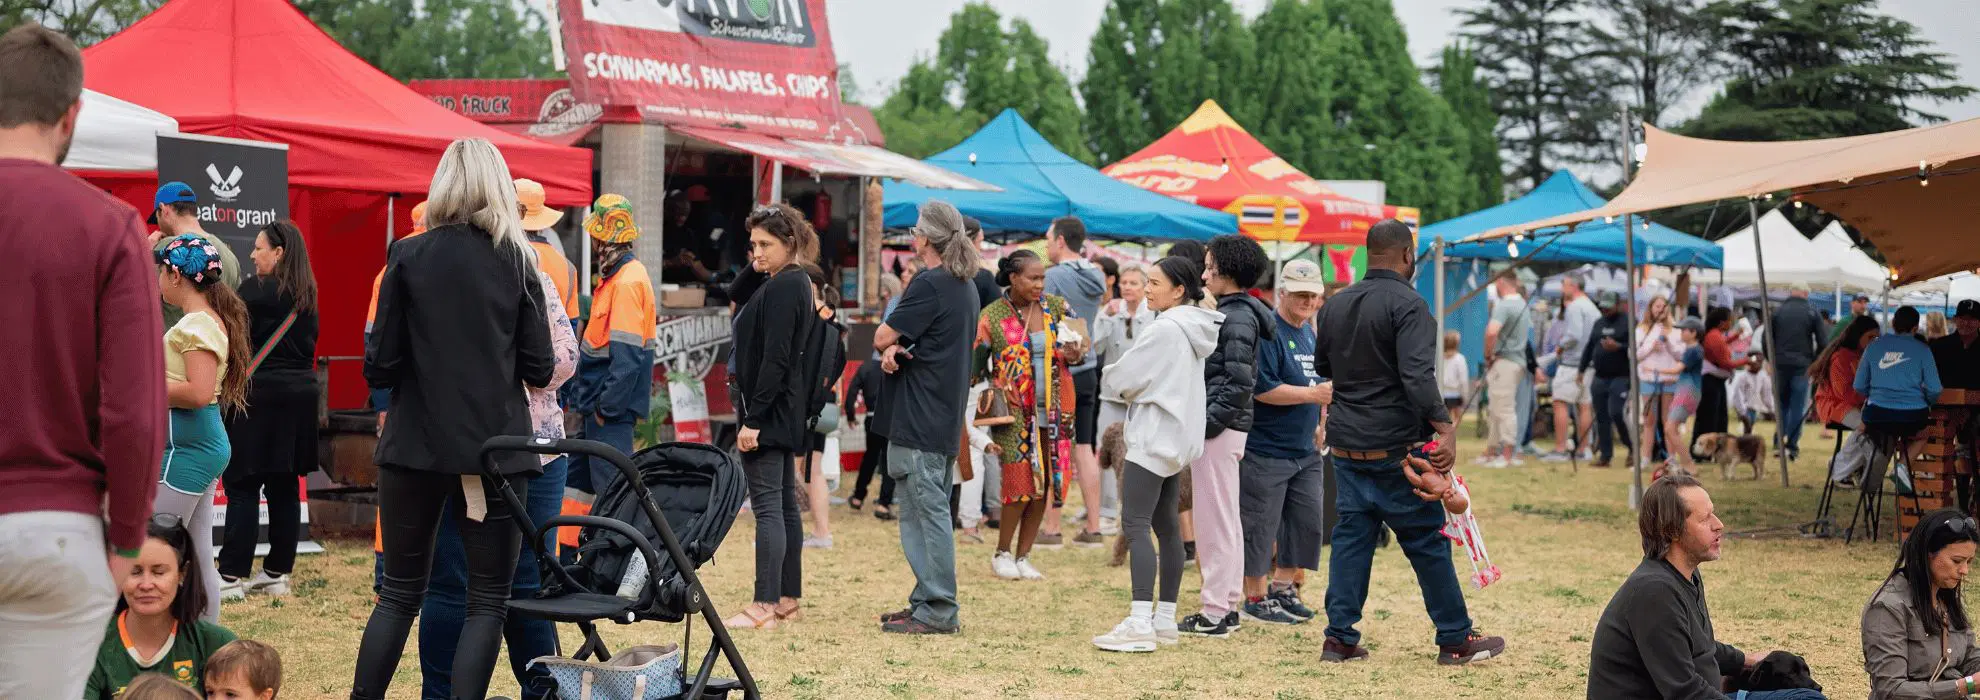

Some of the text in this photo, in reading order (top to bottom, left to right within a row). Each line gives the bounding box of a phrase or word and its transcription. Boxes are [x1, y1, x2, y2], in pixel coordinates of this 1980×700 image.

[710, 18, 772, 40] Schwarma
[583, 52, 699, 91] SCHWARMAS,
[786, 73, 830, 98] CHIPS
